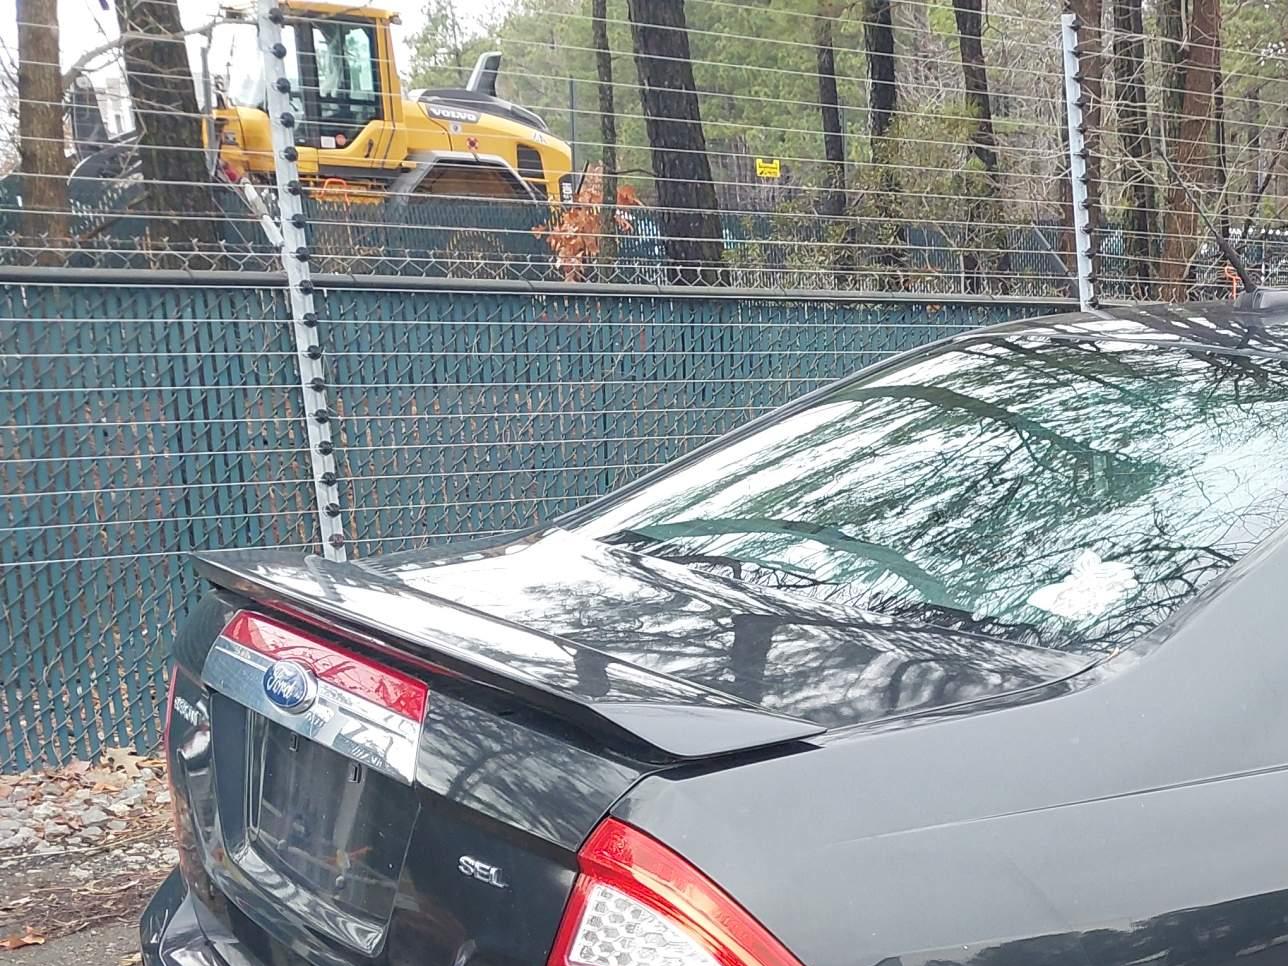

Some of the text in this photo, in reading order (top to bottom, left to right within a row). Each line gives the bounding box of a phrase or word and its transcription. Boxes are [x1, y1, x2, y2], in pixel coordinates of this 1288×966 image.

[430, 107, 477, 121] VOLVO
[266, 667, 304, 700] Ford
[458, 855, 508, 889] SEL
